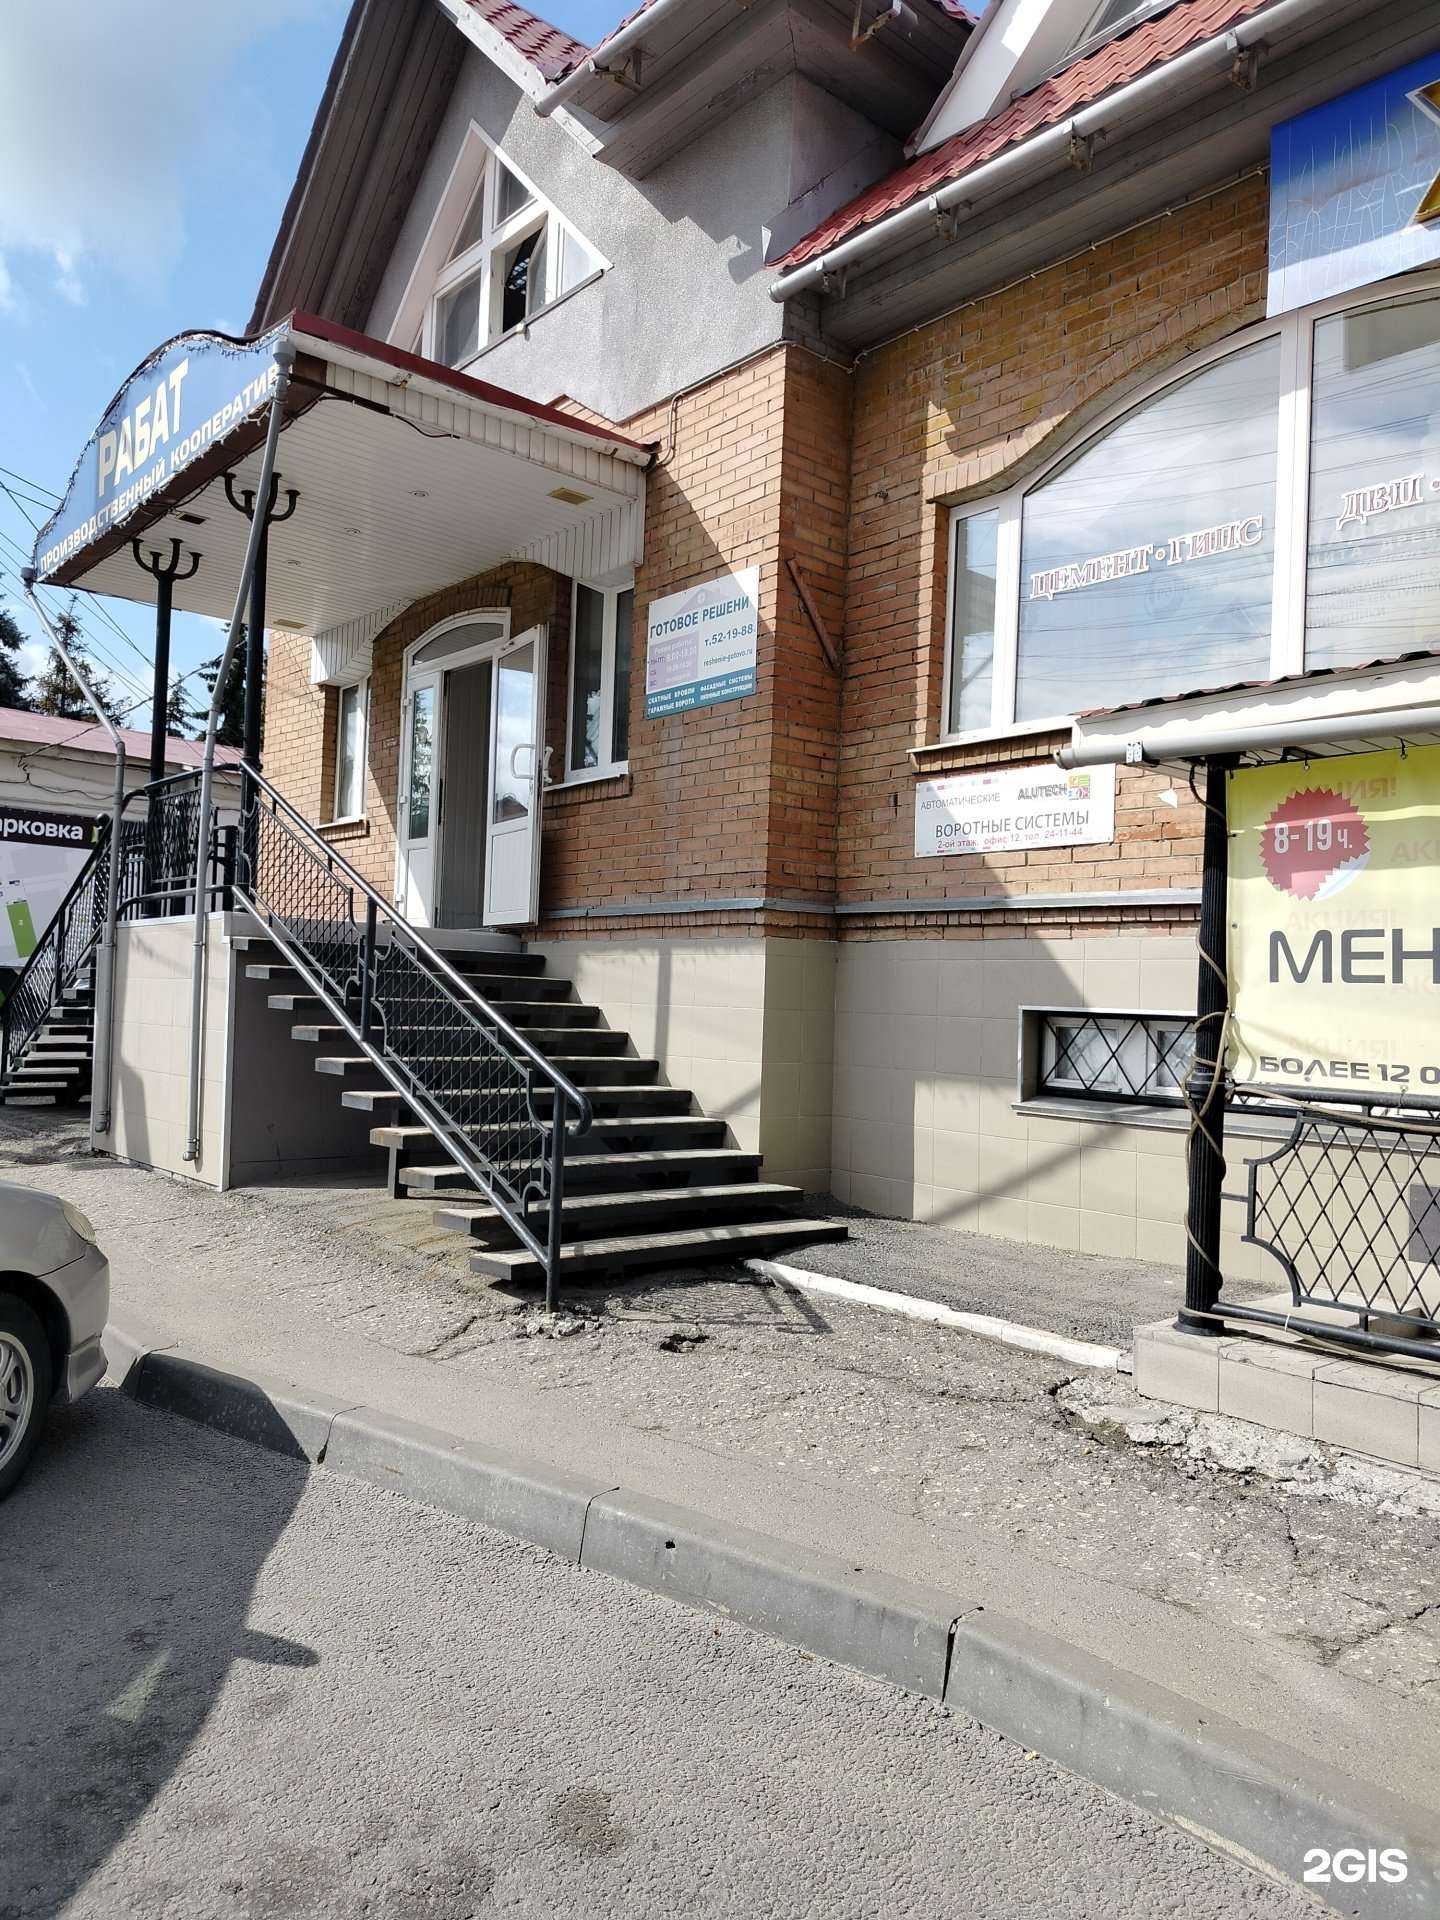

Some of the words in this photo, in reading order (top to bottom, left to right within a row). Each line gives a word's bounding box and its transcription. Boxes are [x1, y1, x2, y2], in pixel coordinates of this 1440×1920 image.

[98, 358, 189, 498] РАБАТ
[40, 456, 166, 571] ПРОИЗВОДСТВЕННЫЙ
[1336, 472, 1426, 531] ДВП
[650, 611, 699, 639] ГОТОВОЕ
[920, 792, 1000, 811] АВТОМАТИЧЕСКИЕ
[1017, 783, 1068, 801] ALUTECH
[0, 816, 83, 841] рковка
[935, 817, 1011, 838] ВОРОТНЫЕ
[1014, 810, 1089, 831] СИСТЕМЫ
[1274, 819, 1332, 854] 8-19
[1269, 928, 1440, 985] МЕН
[1260, 1056, 1370, 1080] БОЛЕЕ
[1377, 1064, 1410, 1083] 12
